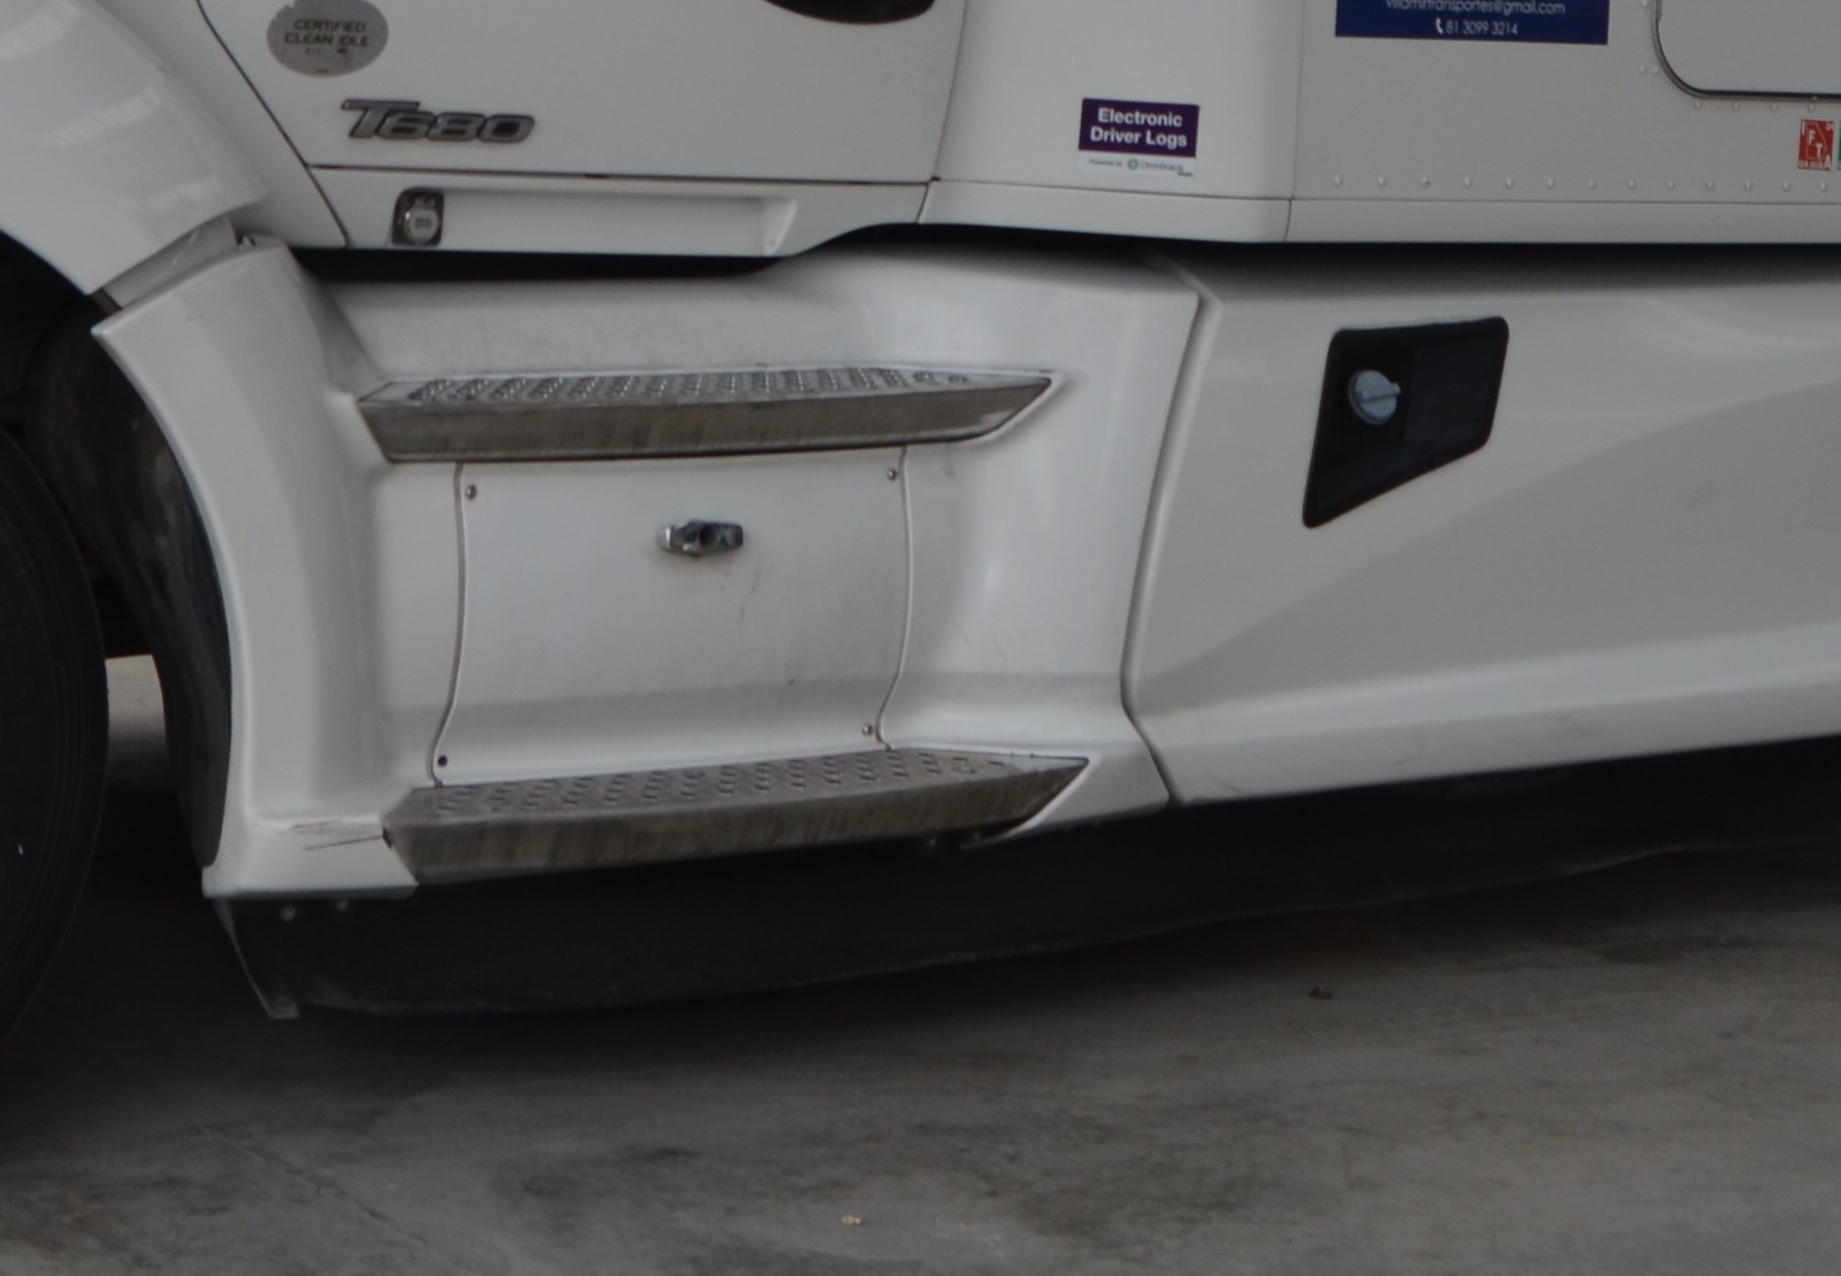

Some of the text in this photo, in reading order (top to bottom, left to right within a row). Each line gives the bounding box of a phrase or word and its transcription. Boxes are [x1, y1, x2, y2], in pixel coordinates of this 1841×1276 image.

[293, 18, 366, 33] CERTIFIED
[1446, 20, 1460, 35] 81
[284, 32, 369, 47] CLEAN IDLE
[341, 99, 536, 144] T680
[1098, 107, 1183, 128] Electronic
[1090, 126, 1188, 150] Driver Logs
